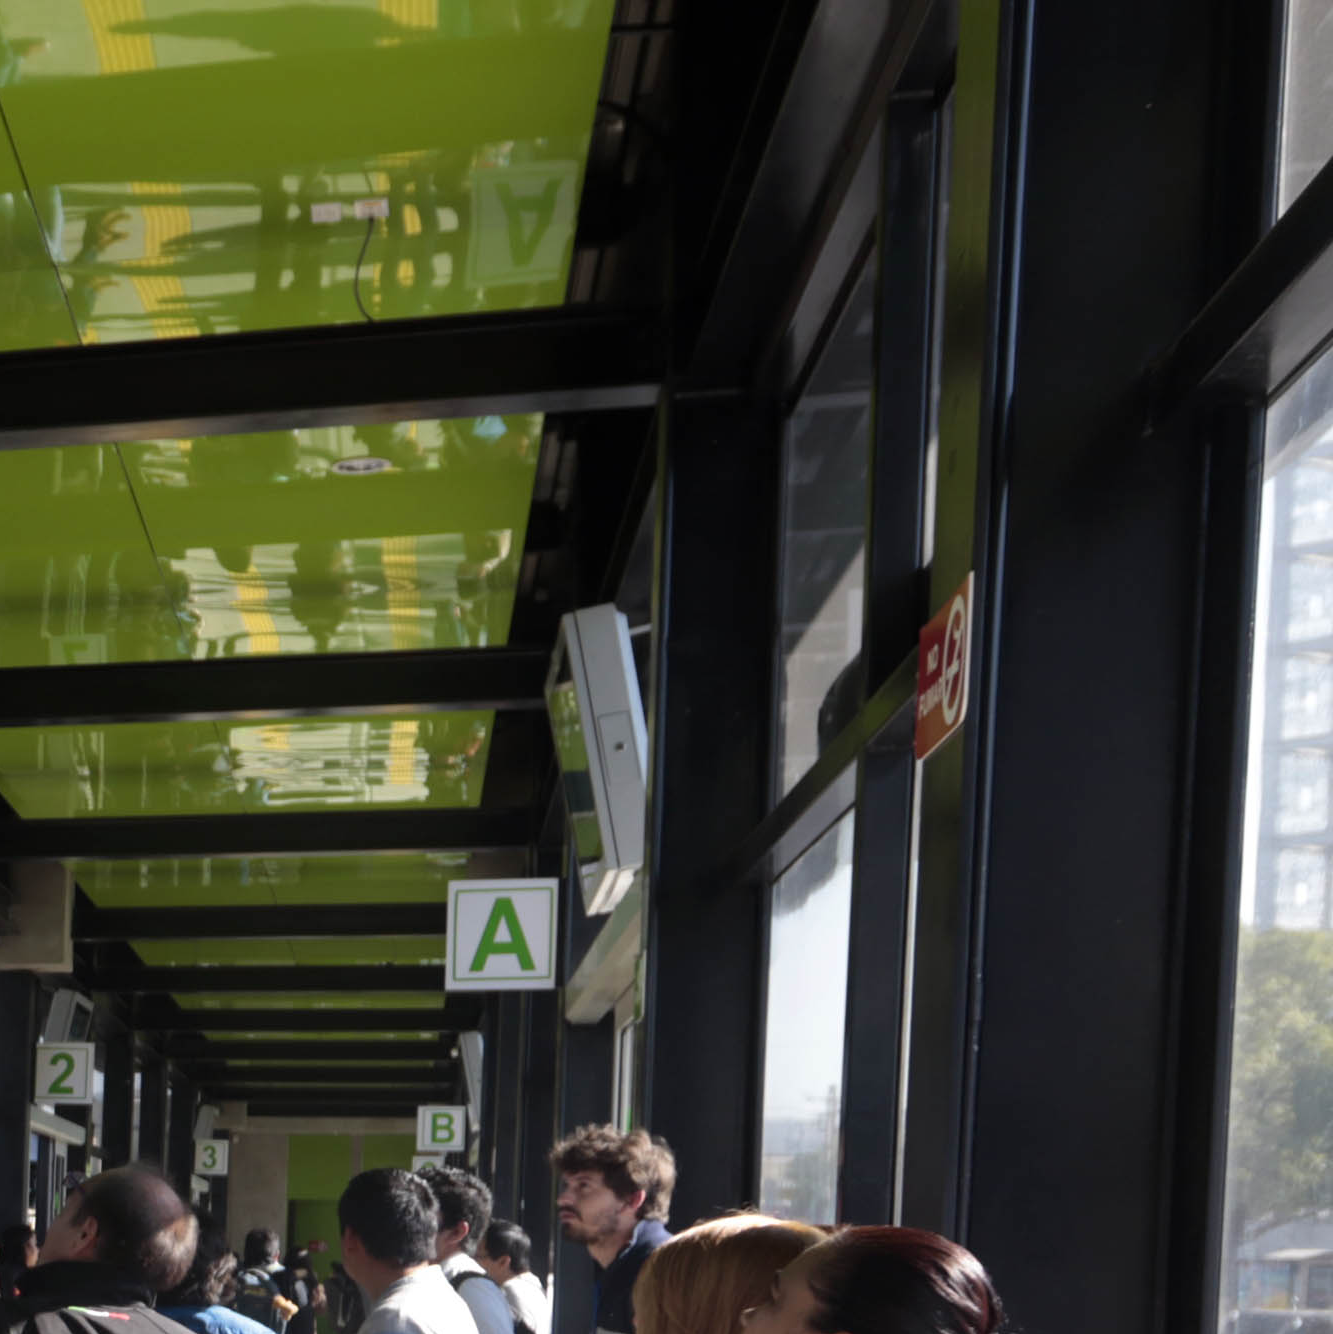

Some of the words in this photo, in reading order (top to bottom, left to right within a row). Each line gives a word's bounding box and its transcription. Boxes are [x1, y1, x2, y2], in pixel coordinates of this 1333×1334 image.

[468, 896, 537, 972] A
[48, 1052, 75, 1095] 2
[431, 1112, 455, 1143] B
[202, 1145, 217, 1169] 3
